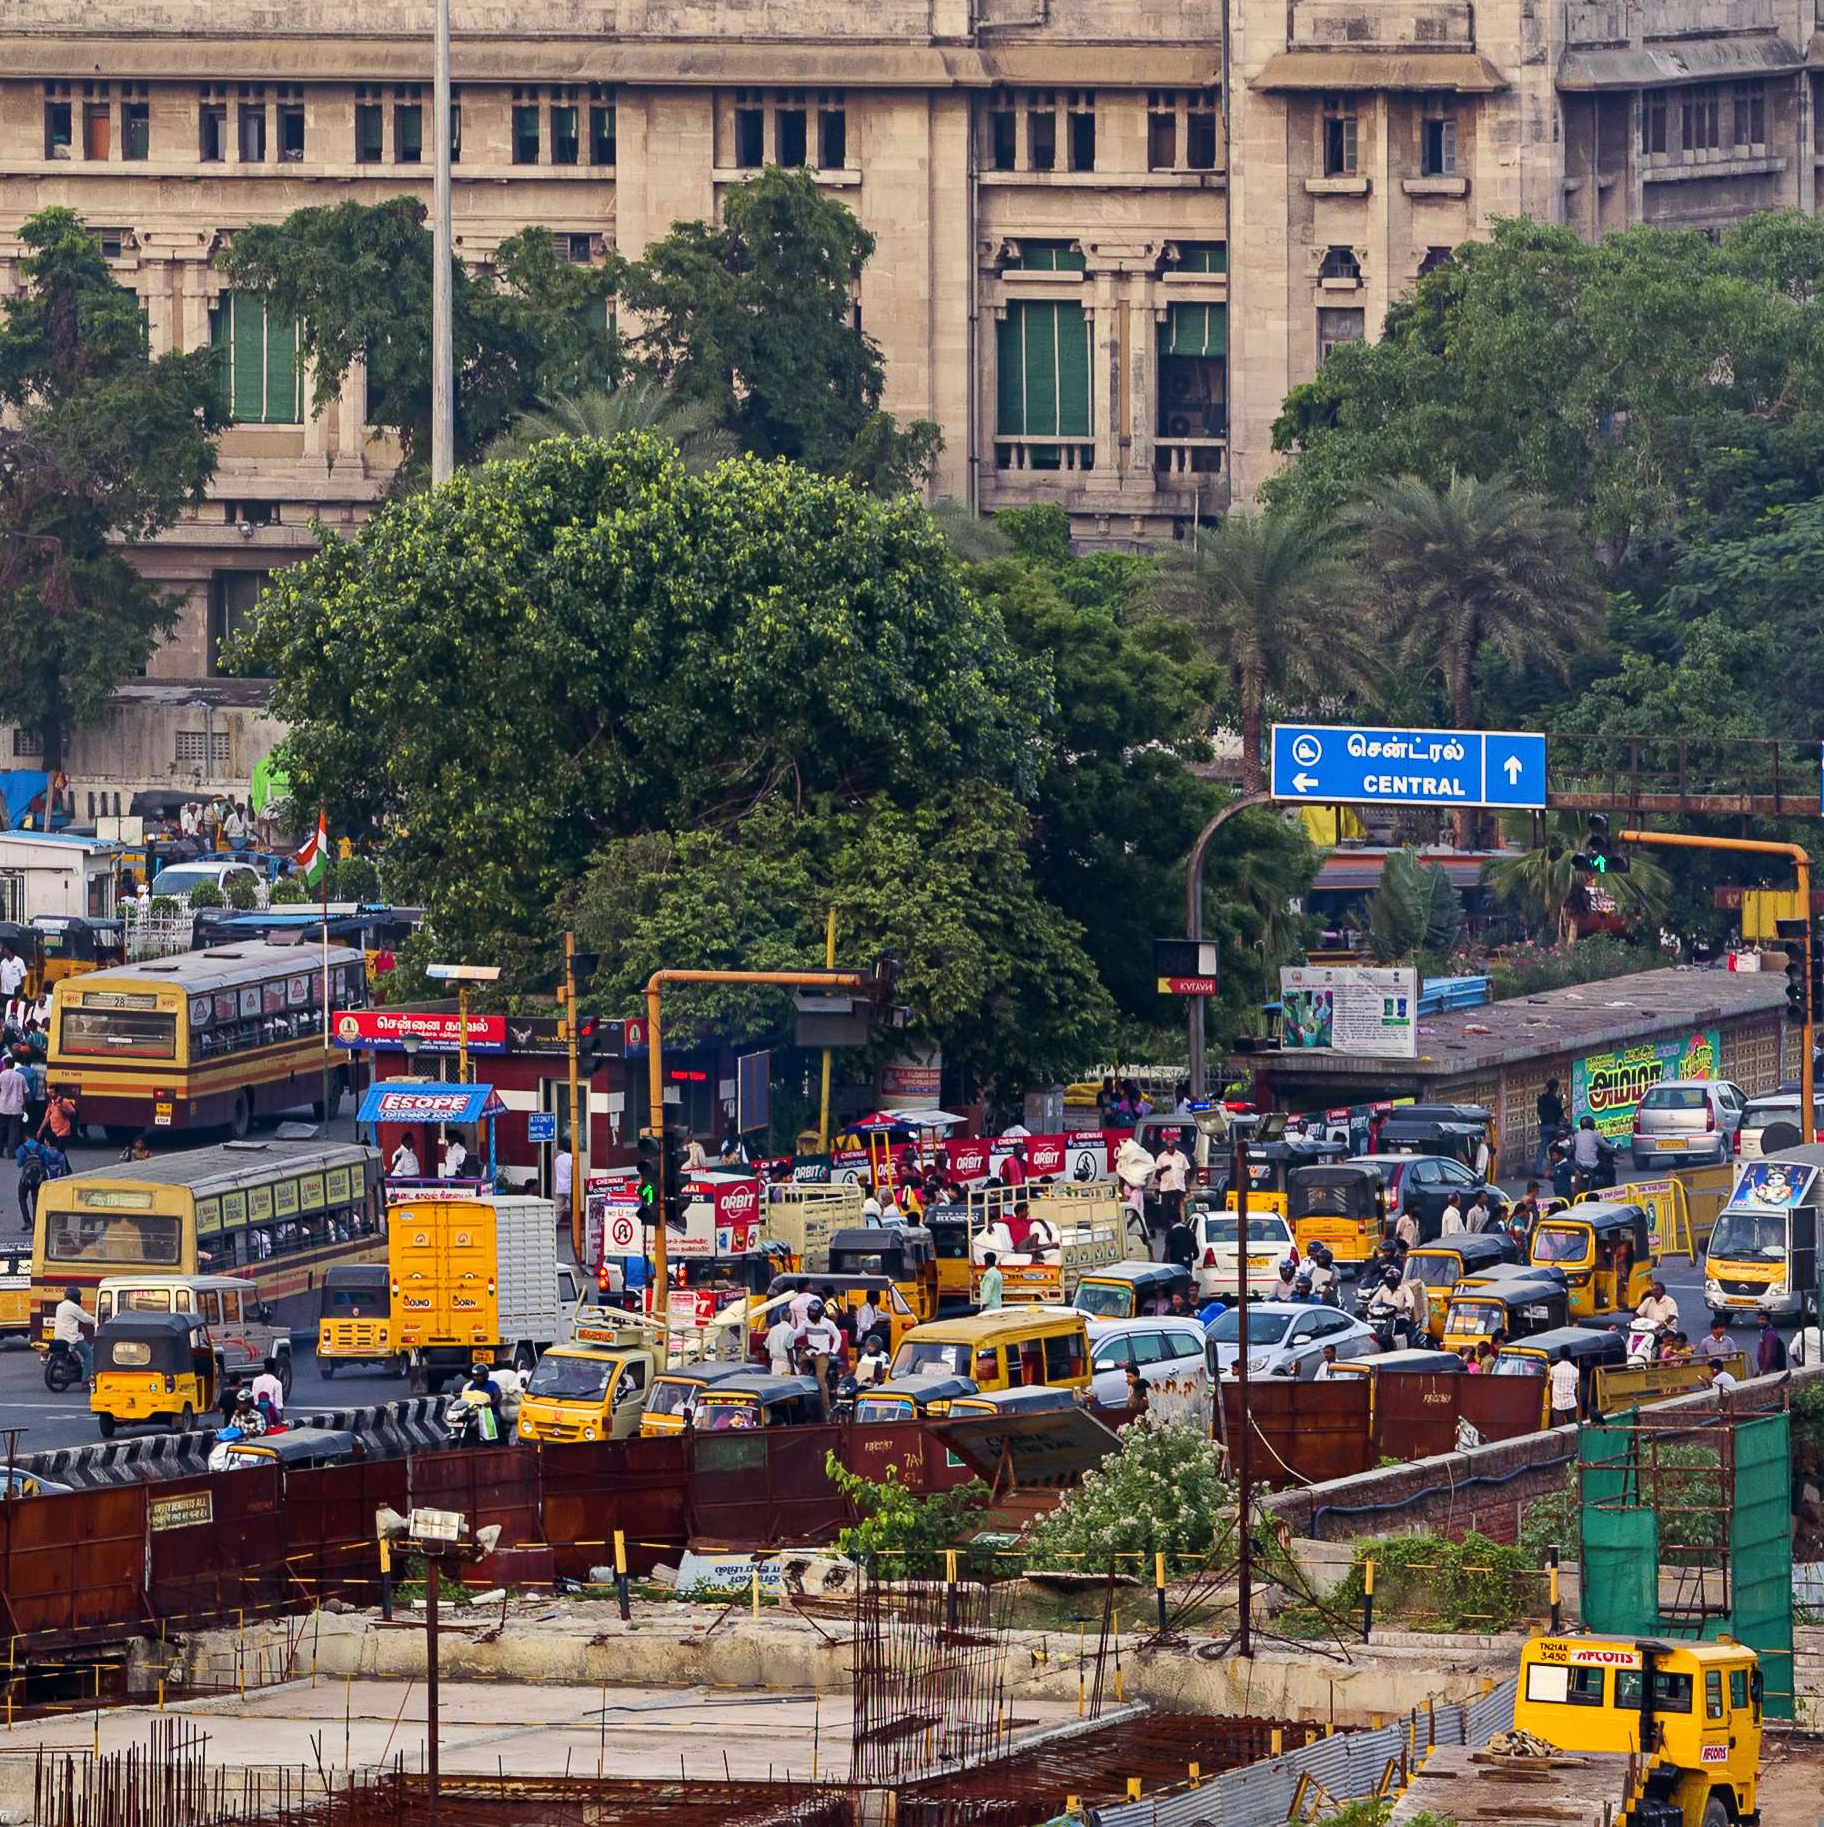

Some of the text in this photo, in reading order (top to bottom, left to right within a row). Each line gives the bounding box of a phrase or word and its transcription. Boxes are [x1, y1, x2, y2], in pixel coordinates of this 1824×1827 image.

[1347, 733, 1465, 763] சென்ட்ரல்
[1364, 774, 1466, 796] CENTRAL
[114, 997, 126, 1008] 28
[377, 1015, 440, 1033] சென்னை
[383, 1094, 468, 1111] ESOPE
[956, 1156, 983, 1170] ORBIT
[1033, 1151, 1060, 1165] ORBIT
[793, 1165, 821, 1179] ORBIT
[721, 1193, 755, 1211] ORBIT
